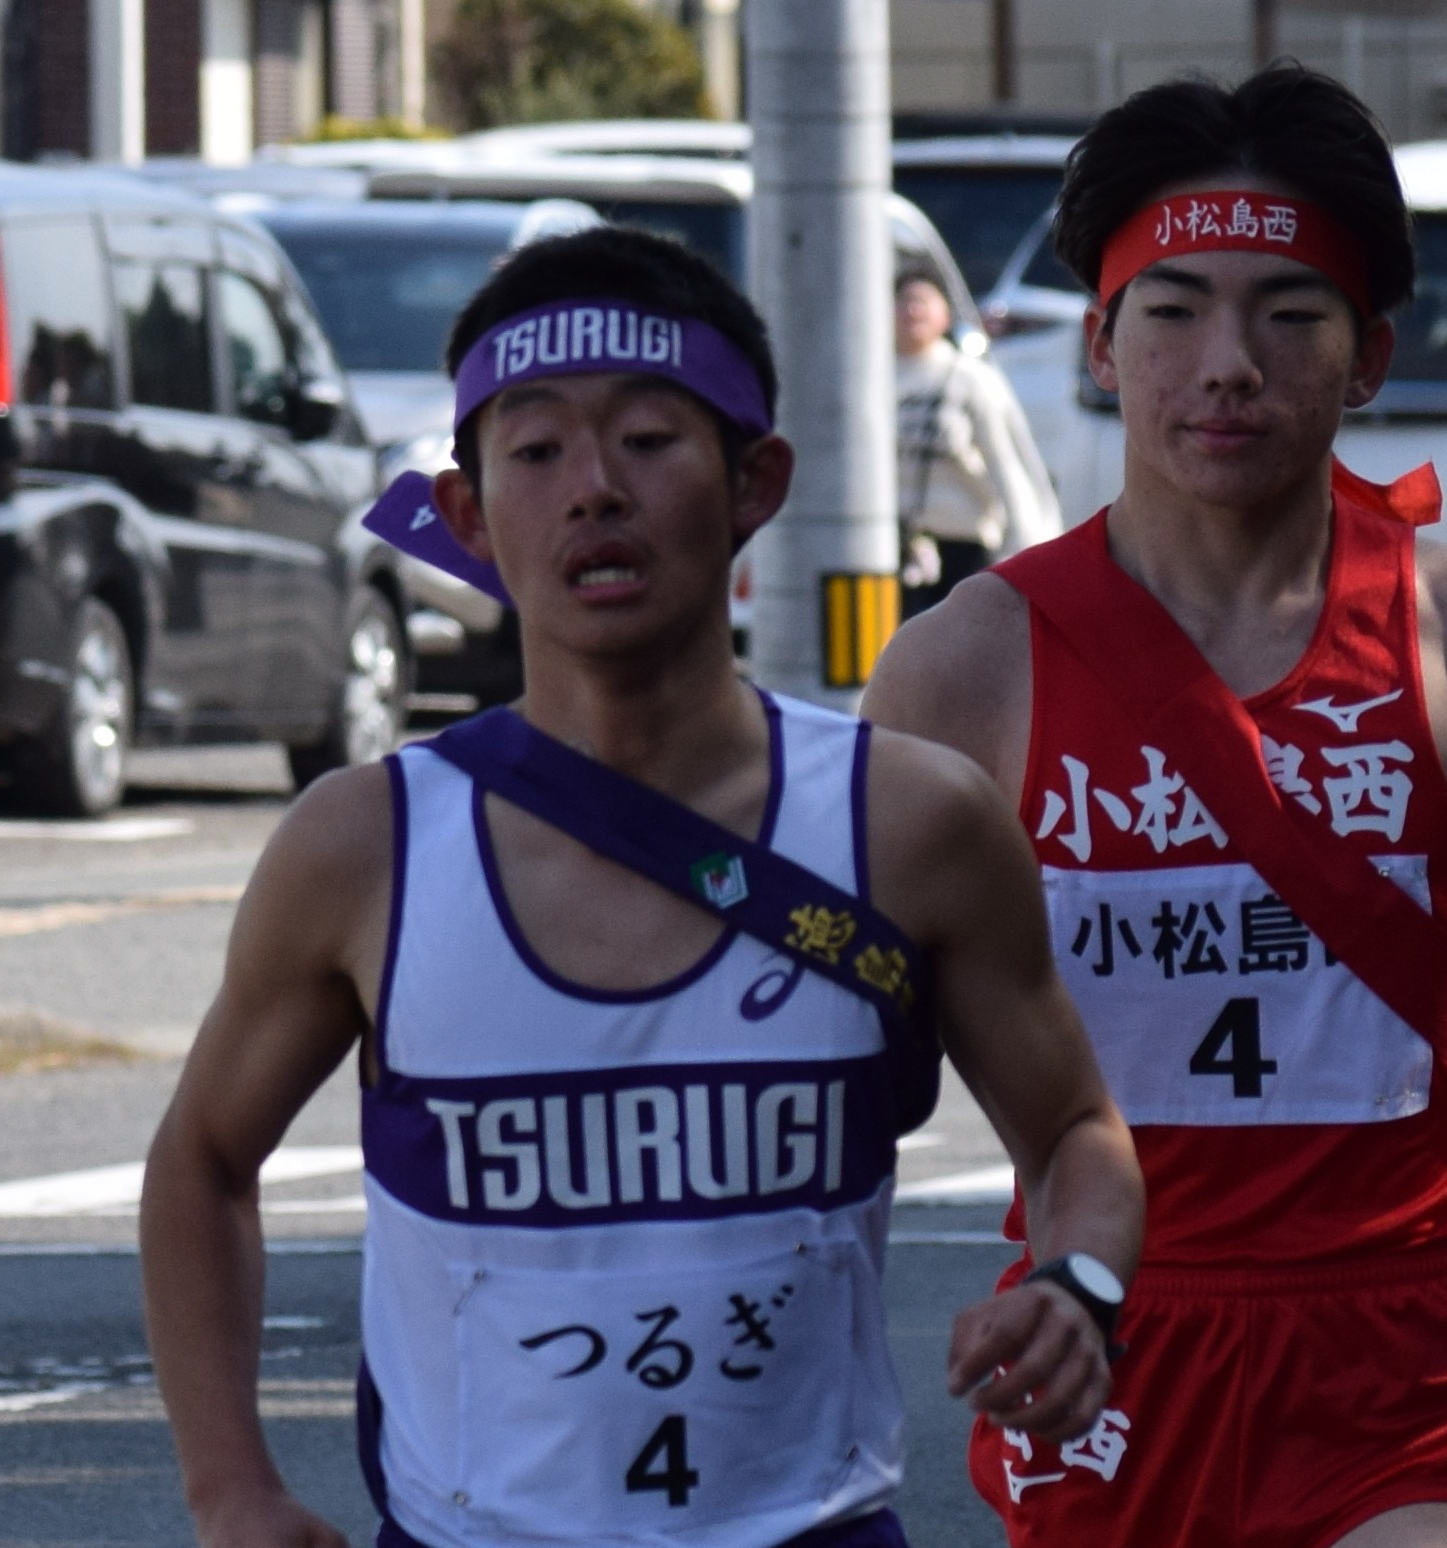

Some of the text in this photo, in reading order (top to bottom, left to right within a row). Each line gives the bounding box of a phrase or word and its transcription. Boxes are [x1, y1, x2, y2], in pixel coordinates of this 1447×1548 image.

[1155, 197, 1298, 246] 小松島西
[493, 307, 683, 381] TSURUGI
[1070, 893, 1339, 980] 小松島
[1188, 996, 1278, 1099] 4
[426, 1079, 845, 1211] TSURUGI
[518, 1284, 794, 1390] つるぎ
[625, 1414, 700, 1507] 4
